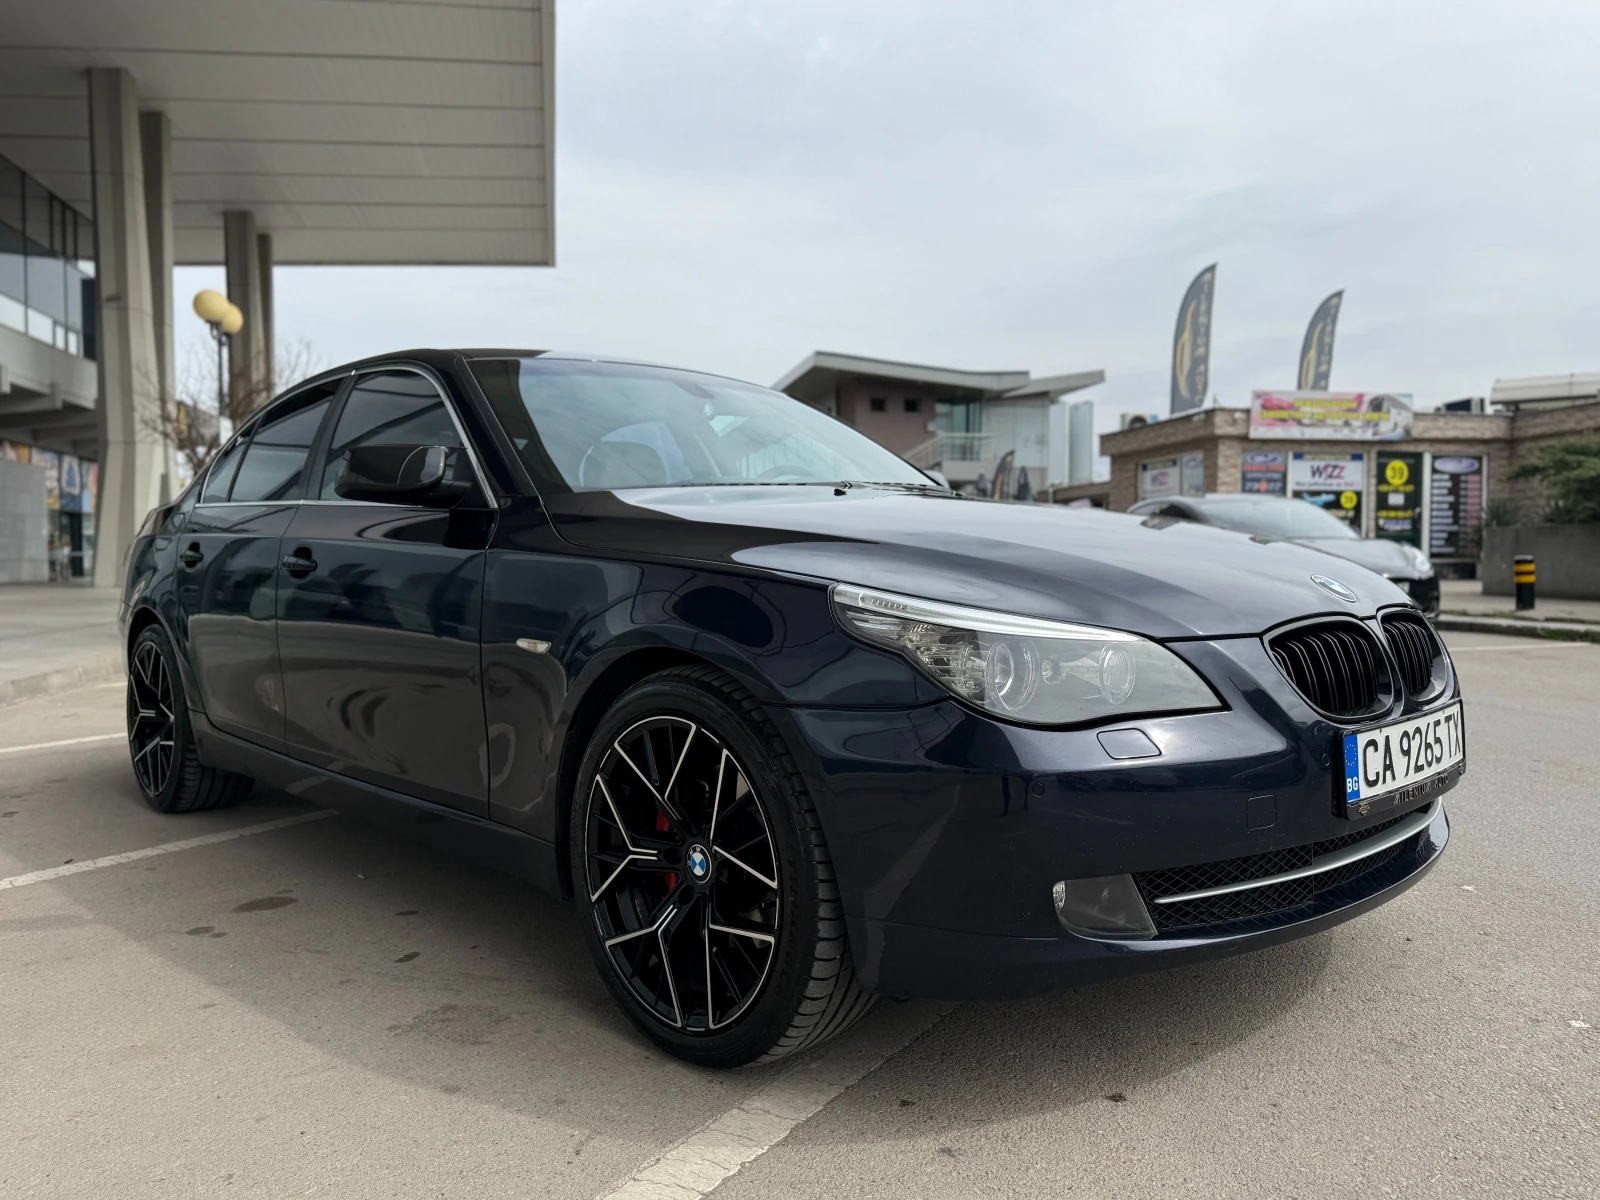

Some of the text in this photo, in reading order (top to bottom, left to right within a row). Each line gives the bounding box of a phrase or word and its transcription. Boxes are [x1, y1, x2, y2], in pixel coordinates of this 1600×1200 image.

[1391, 466, 1405, 480] 39
[1363, 710, 1461, 788] CA 9265 TX
[1347, 777, 1359, 793] BG
